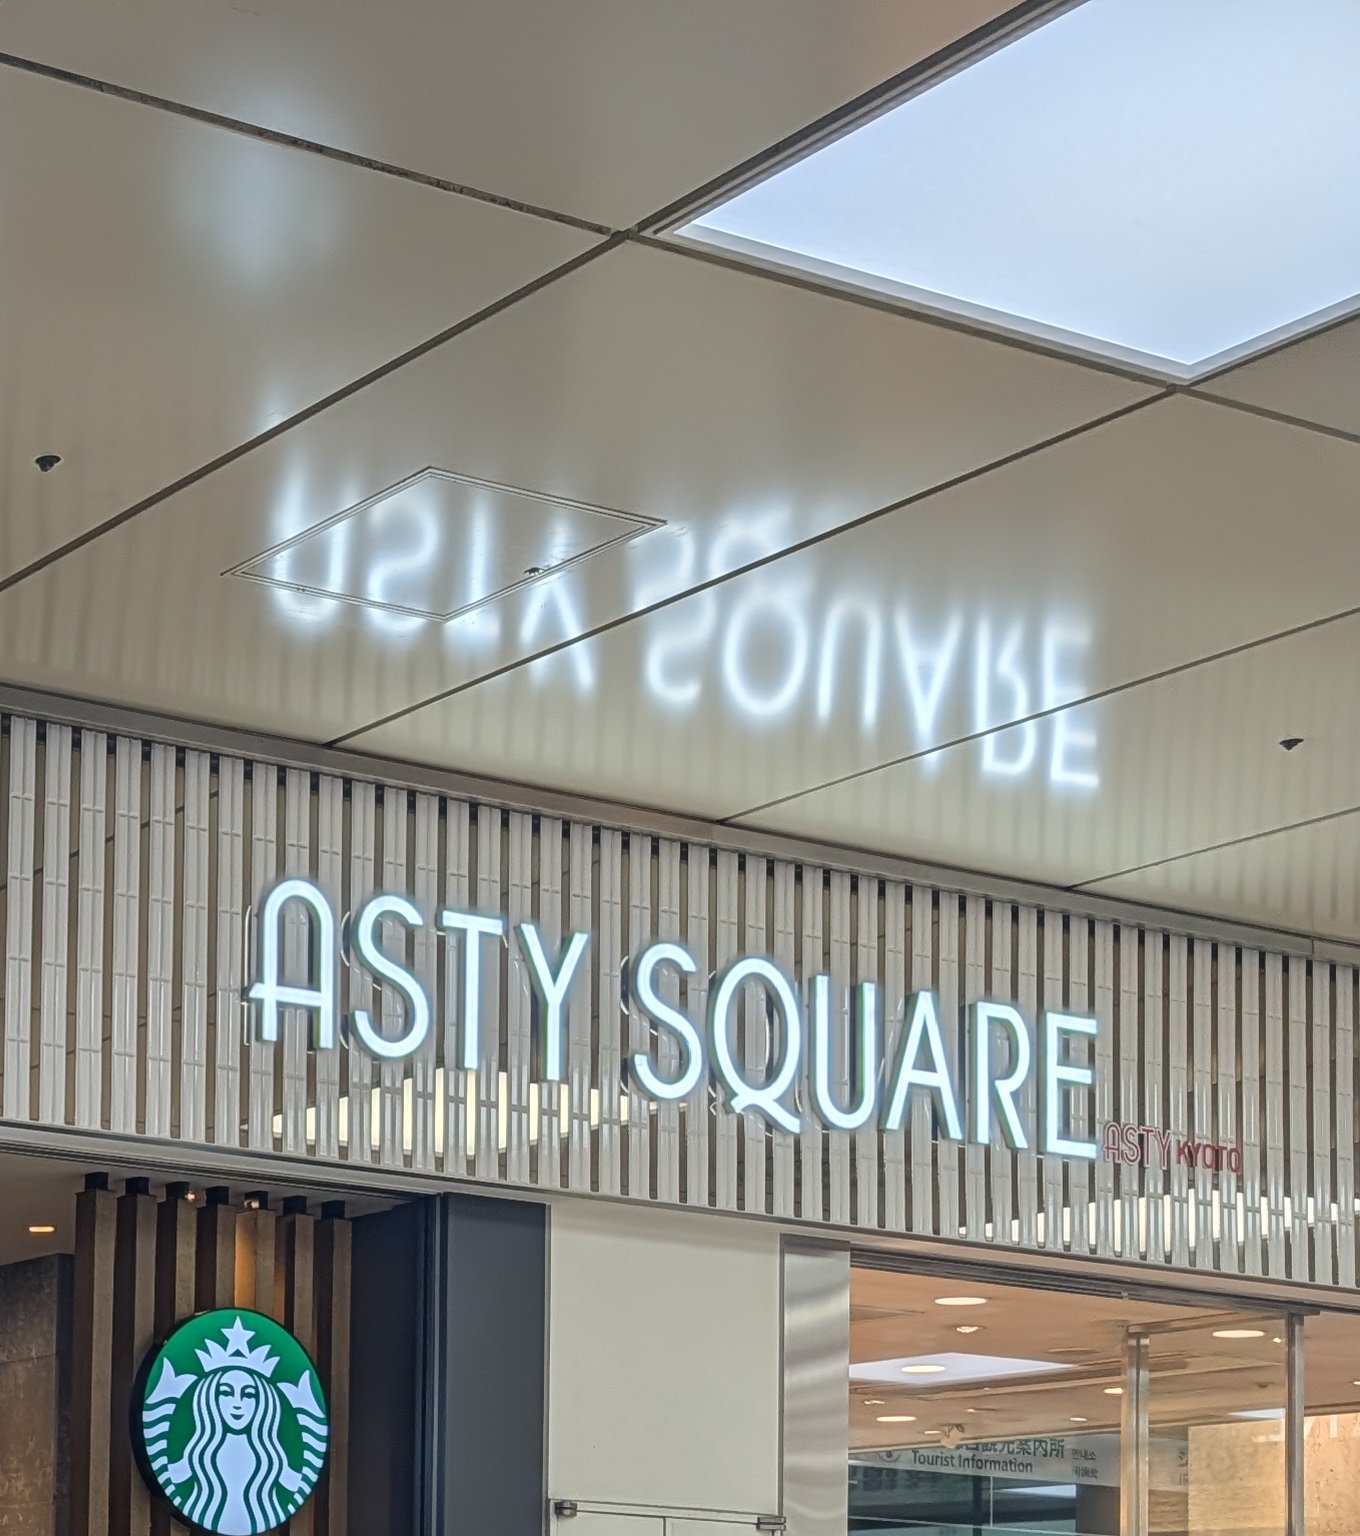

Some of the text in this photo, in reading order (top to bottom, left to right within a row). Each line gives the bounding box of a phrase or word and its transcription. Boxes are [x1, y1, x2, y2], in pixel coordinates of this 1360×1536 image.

[247, 879, 1100, 1159] ASTY SQUARE
[1104, 1122, 1242, 1173] ASTY KYOTO
[911, 1450, 1033, 1473] Tourist Information
